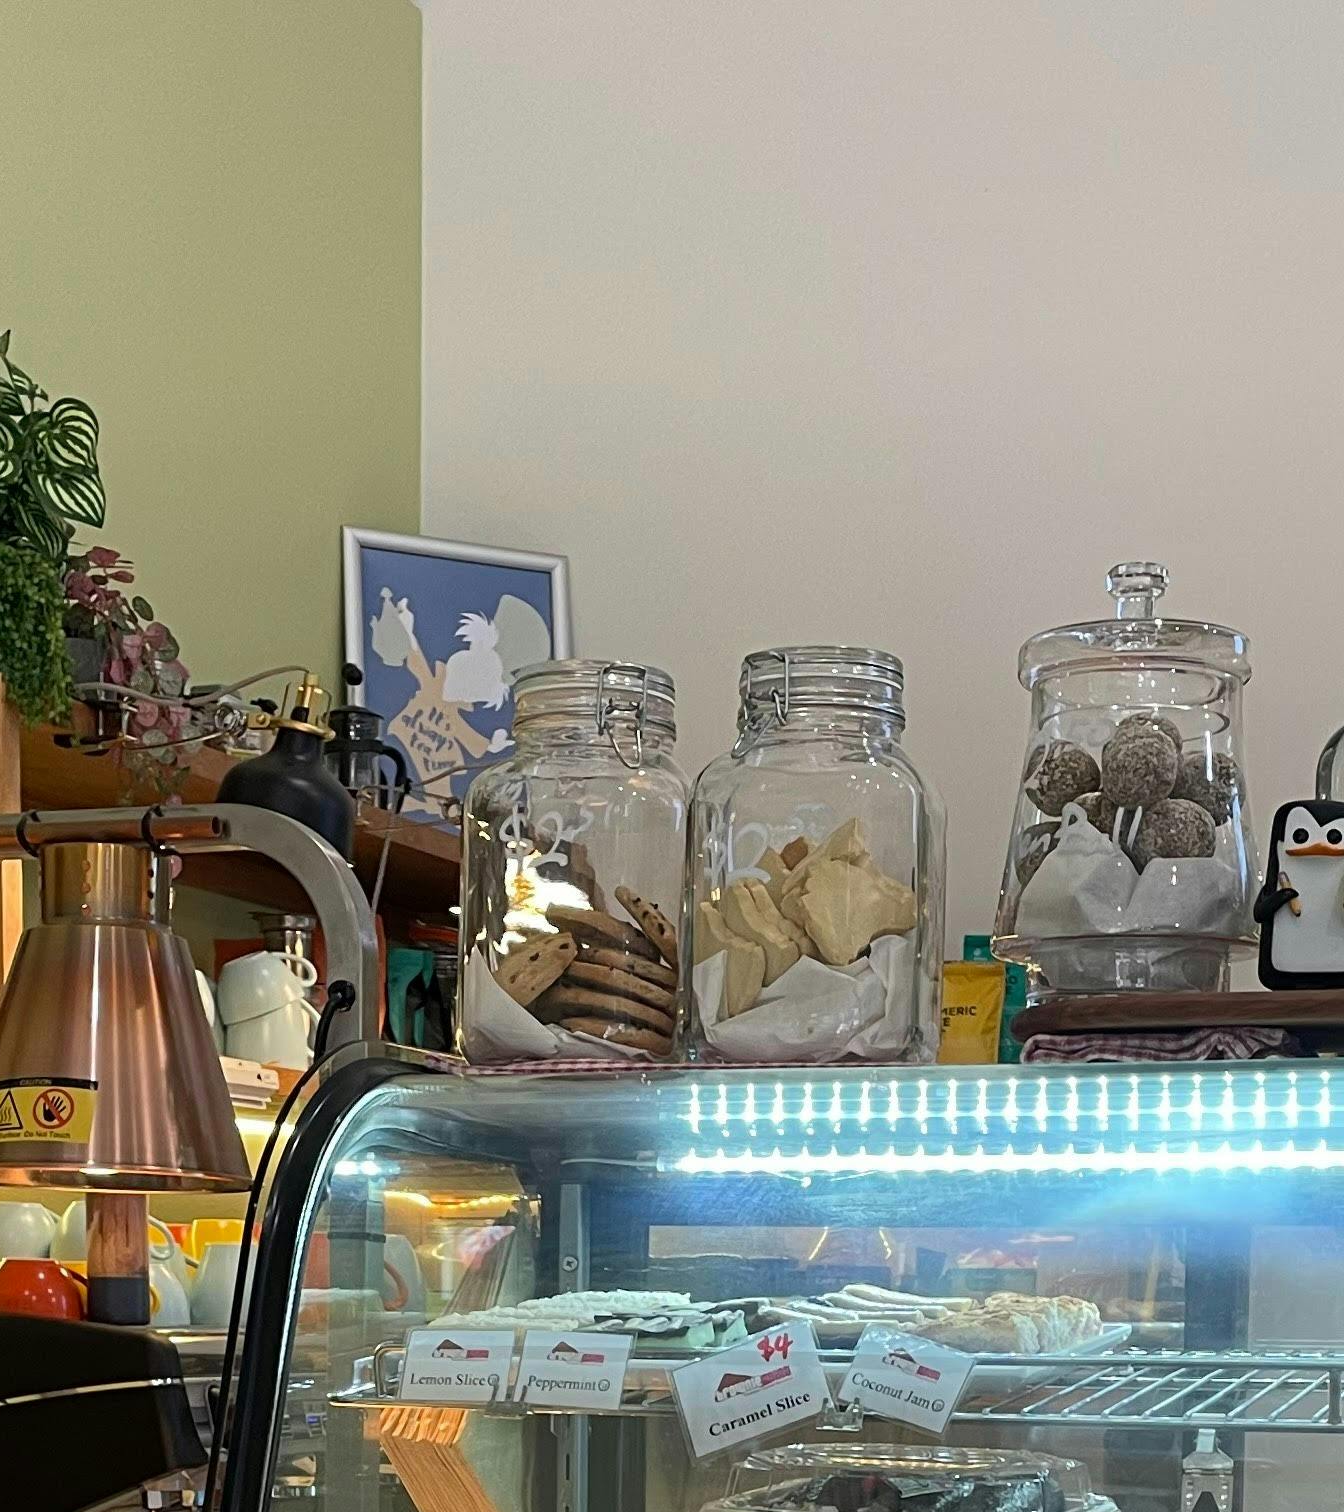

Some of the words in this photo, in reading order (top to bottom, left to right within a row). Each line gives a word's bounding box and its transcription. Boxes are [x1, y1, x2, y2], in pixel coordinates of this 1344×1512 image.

[757, 1333, 794, 1361] $4
[410, 1373, 452, 1386] Lemon
[455, 1373, 487, 1386] Slice
[528, 1375, 597, 1391] Peppermint
[851, 1372, 904, 1401] Coconut
[905, 1391, 931, 1410] Jam
[709, 1404, 773, 1437] Caramel
[776, 1391, 811, 1412] Slice
